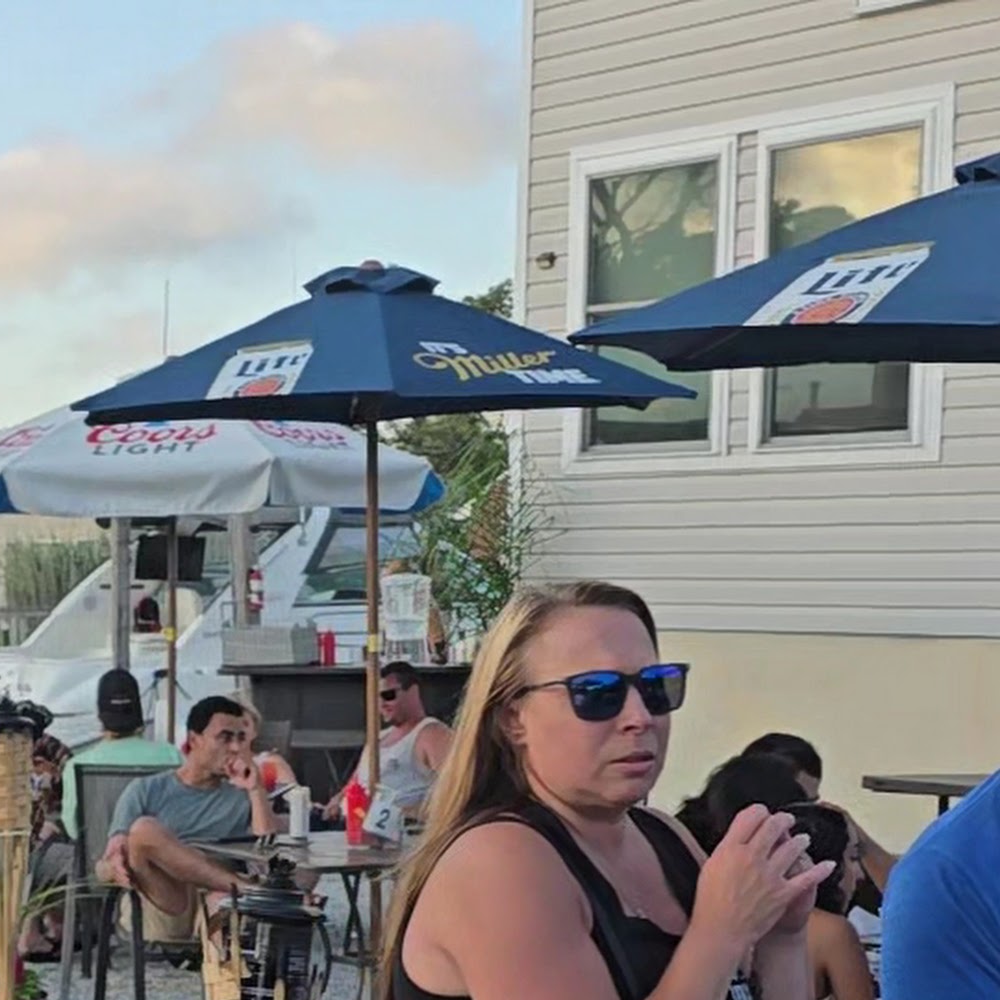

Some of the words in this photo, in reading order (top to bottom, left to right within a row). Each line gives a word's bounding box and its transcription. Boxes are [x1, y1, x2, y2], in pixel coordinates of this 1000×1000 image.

[412, 350, 557, 382] Miller
[504, 367, 602, 385] TIME
[86, 423, 217, 444] Coors
[92, 441, 198, 456] LIGHT
[375, 808, 391, 831] 2
